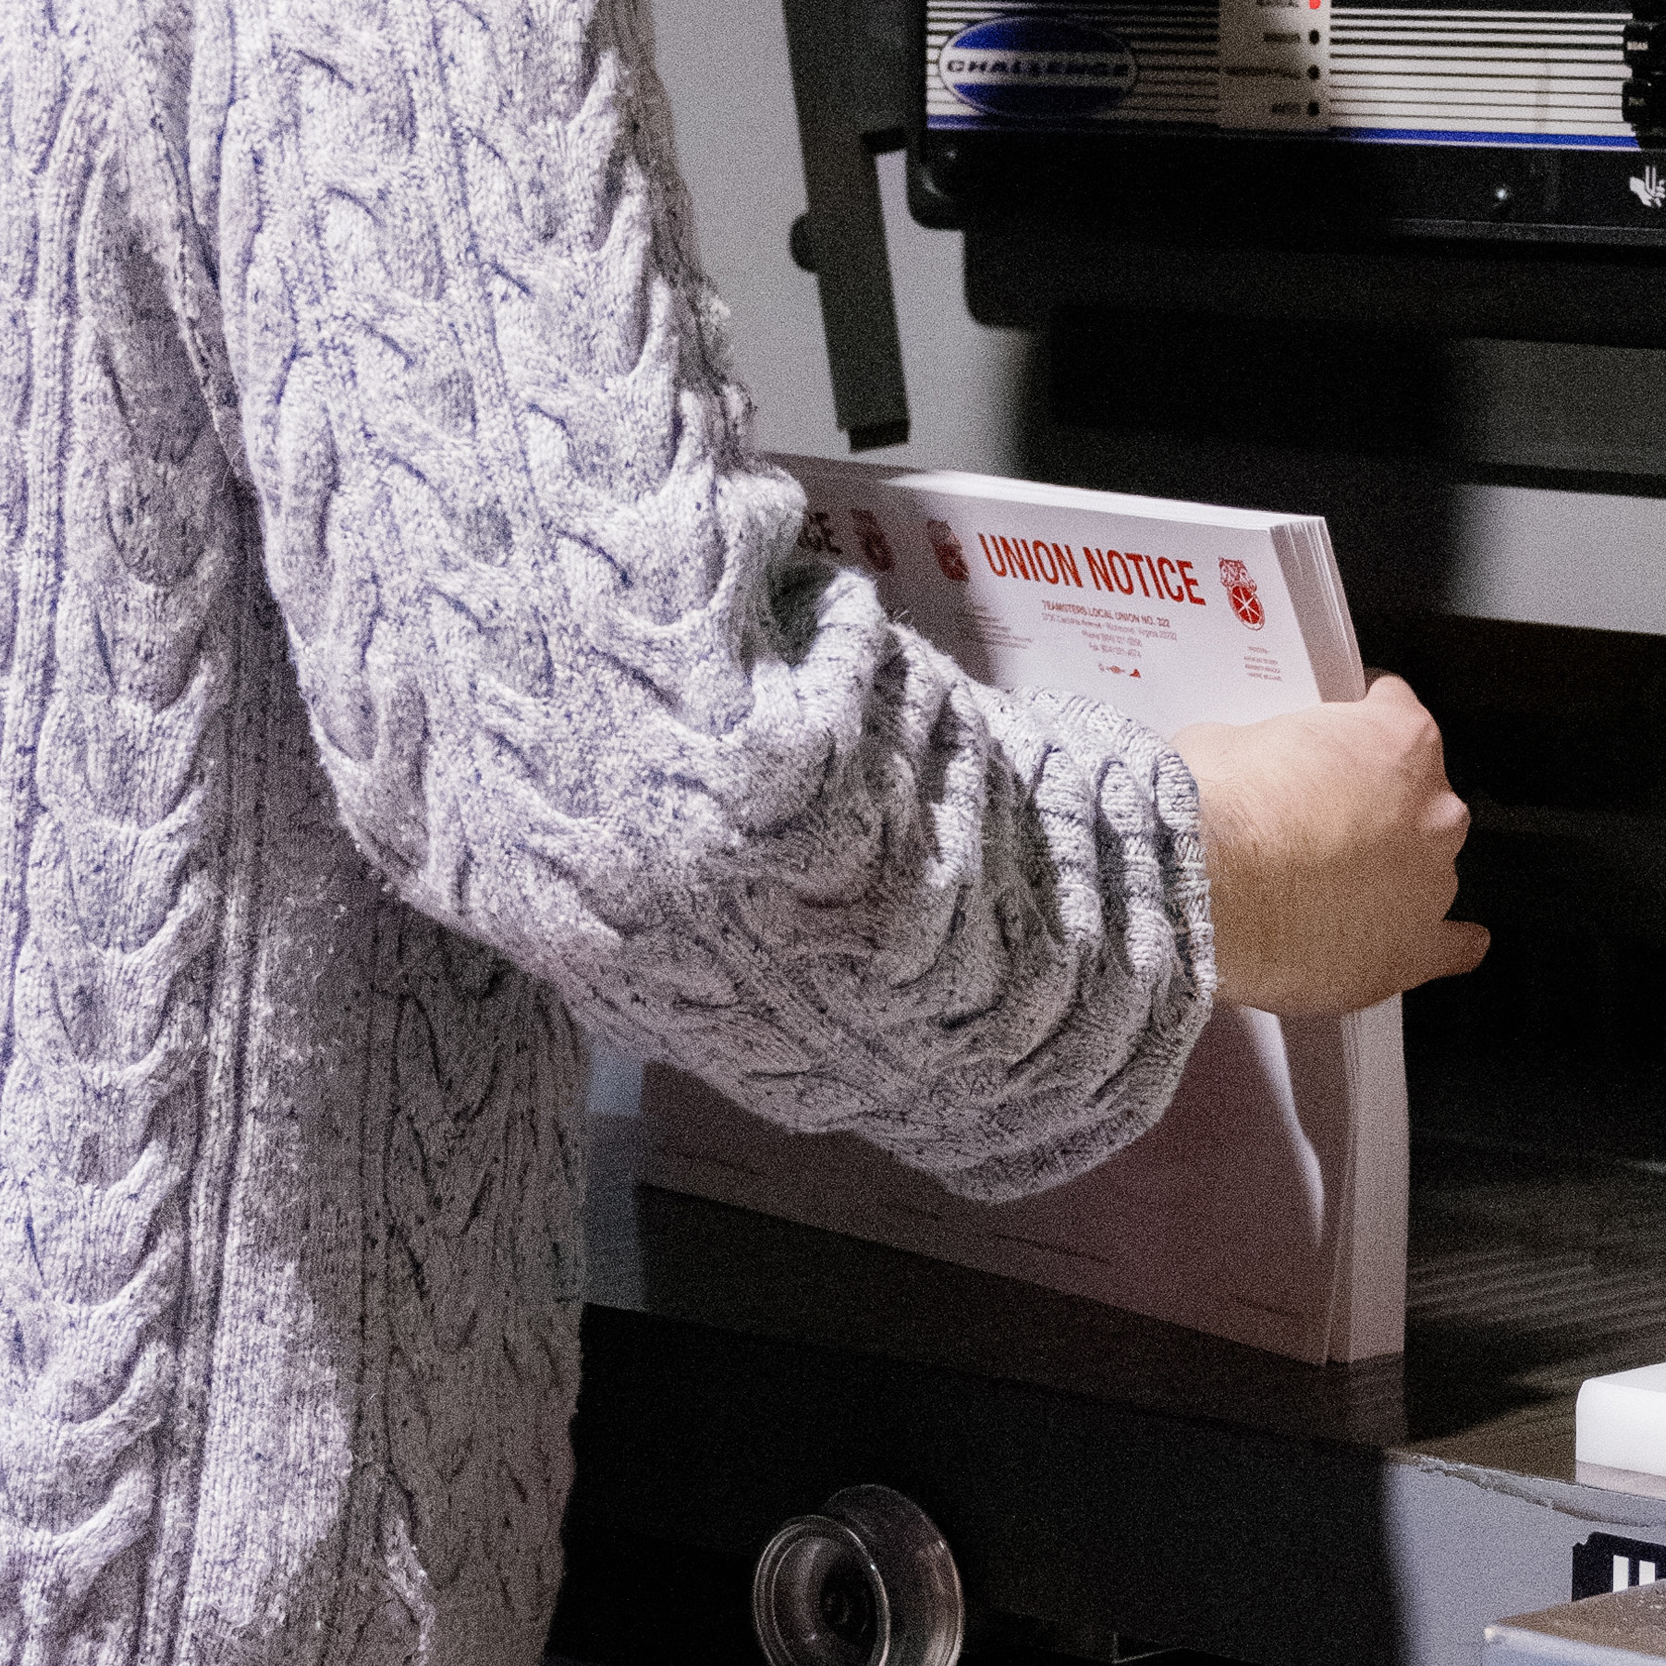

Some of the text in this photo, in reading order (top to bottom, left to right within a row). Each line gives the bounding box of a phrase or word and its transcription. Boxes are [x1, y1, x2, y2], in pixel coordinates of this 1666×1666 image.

[946, 59, 1130, 79] CHALLENGE
[977, 532, 1207, 606] UNION NOTICE
[1114, 611, 1141, 623] UNION
